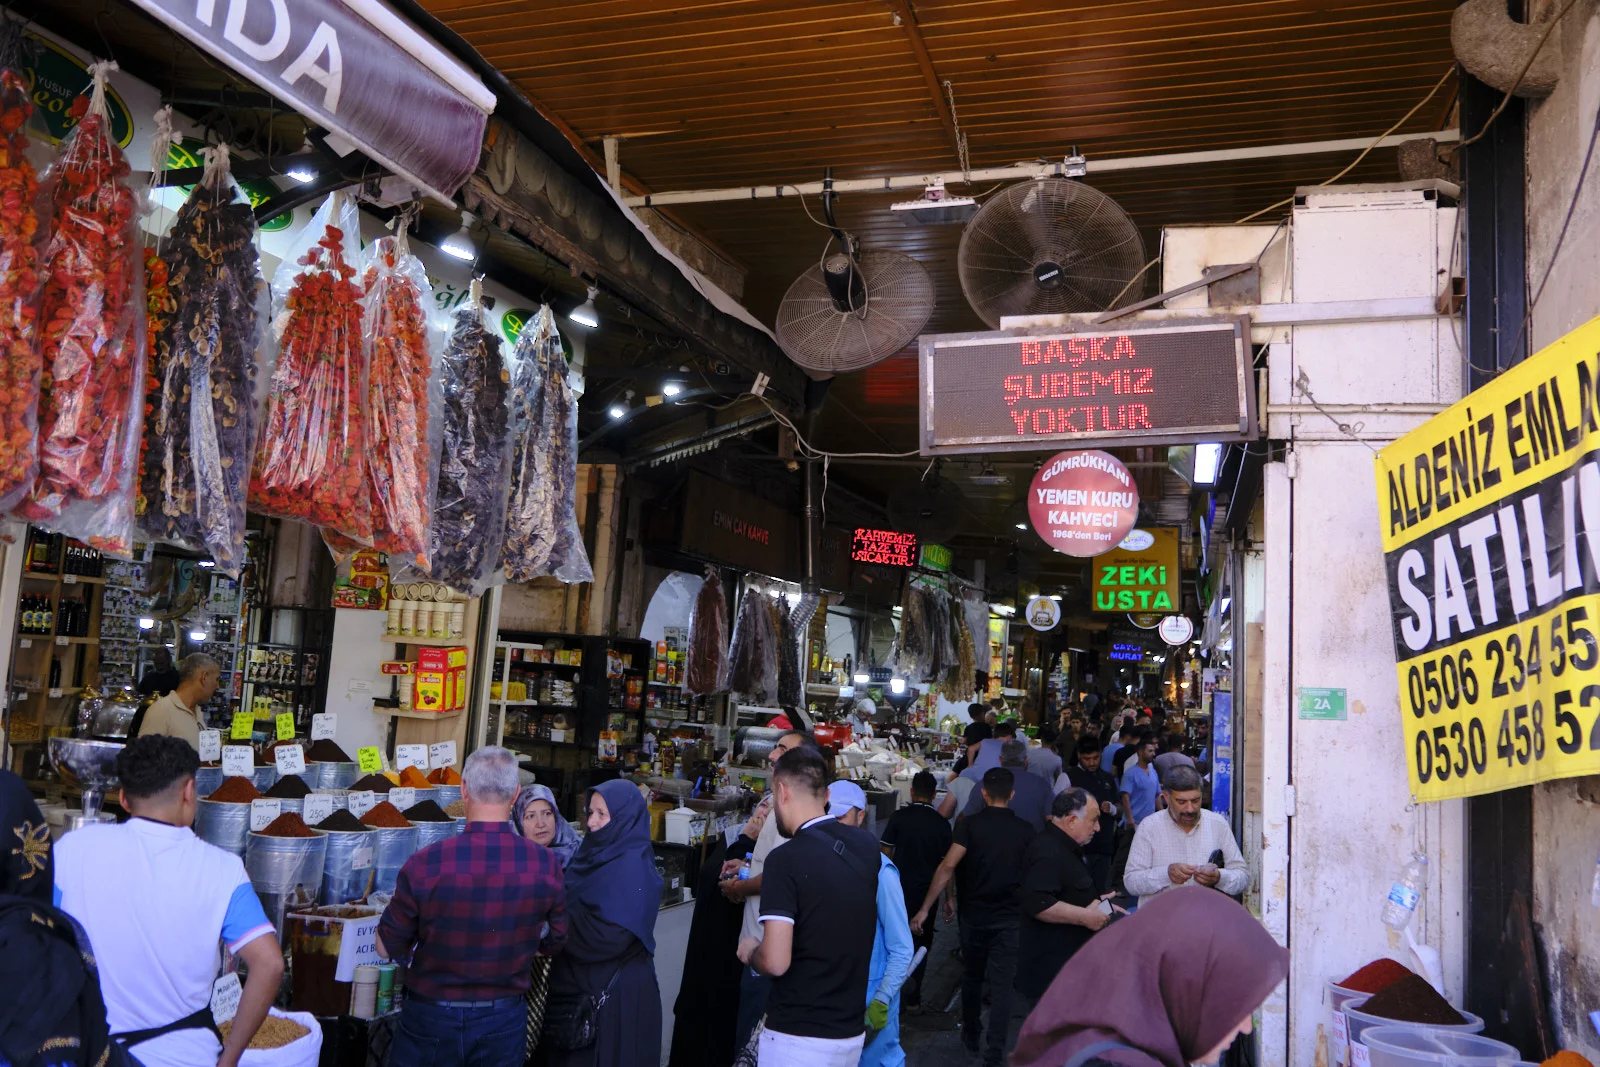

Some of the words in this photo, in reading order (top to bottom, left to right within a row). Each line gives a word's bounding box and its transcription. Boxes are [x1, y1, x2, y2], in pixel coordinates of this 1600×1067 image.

[37, 75, 73, 98] YUSUF
[1020, 335, 1136, 367] BAŞKA
[1010, 404, 1152, 435] YOKTUR
[1388, 406, 1502, 538] ALDENİZ
[1504, 352, 1600, 476] EMLA
[1037, 488, 1087, 506] YEMEN
[1091, 490, 1133, 509] KURU
[747, 524, 769, 546] KAHVE
[1052, 529, 1092, 541] 1968'den
[1093, 532, 1112, 541] Beri
[854, 550, 911, 567] SICAKTIR
[862, 541, 891, 554] TAZE
[893, 543, 909, 556] VE
[1097, 590, 1173, 610] USTA
[1109, 651, 1144, 662] MURAT
[1408, 648, 1479, 719] 0506
[1485, 625, 1542, 699] 234
[1550, 606, 1599, 678] 55
[1314, 697, 1332, 710] 2A
[1416, 717, 1487, 784] 0530
[1496, 699, 1546, 768] 458
[357, 926, 368, 937] EV
[355, 944, 369, 955] ACI
